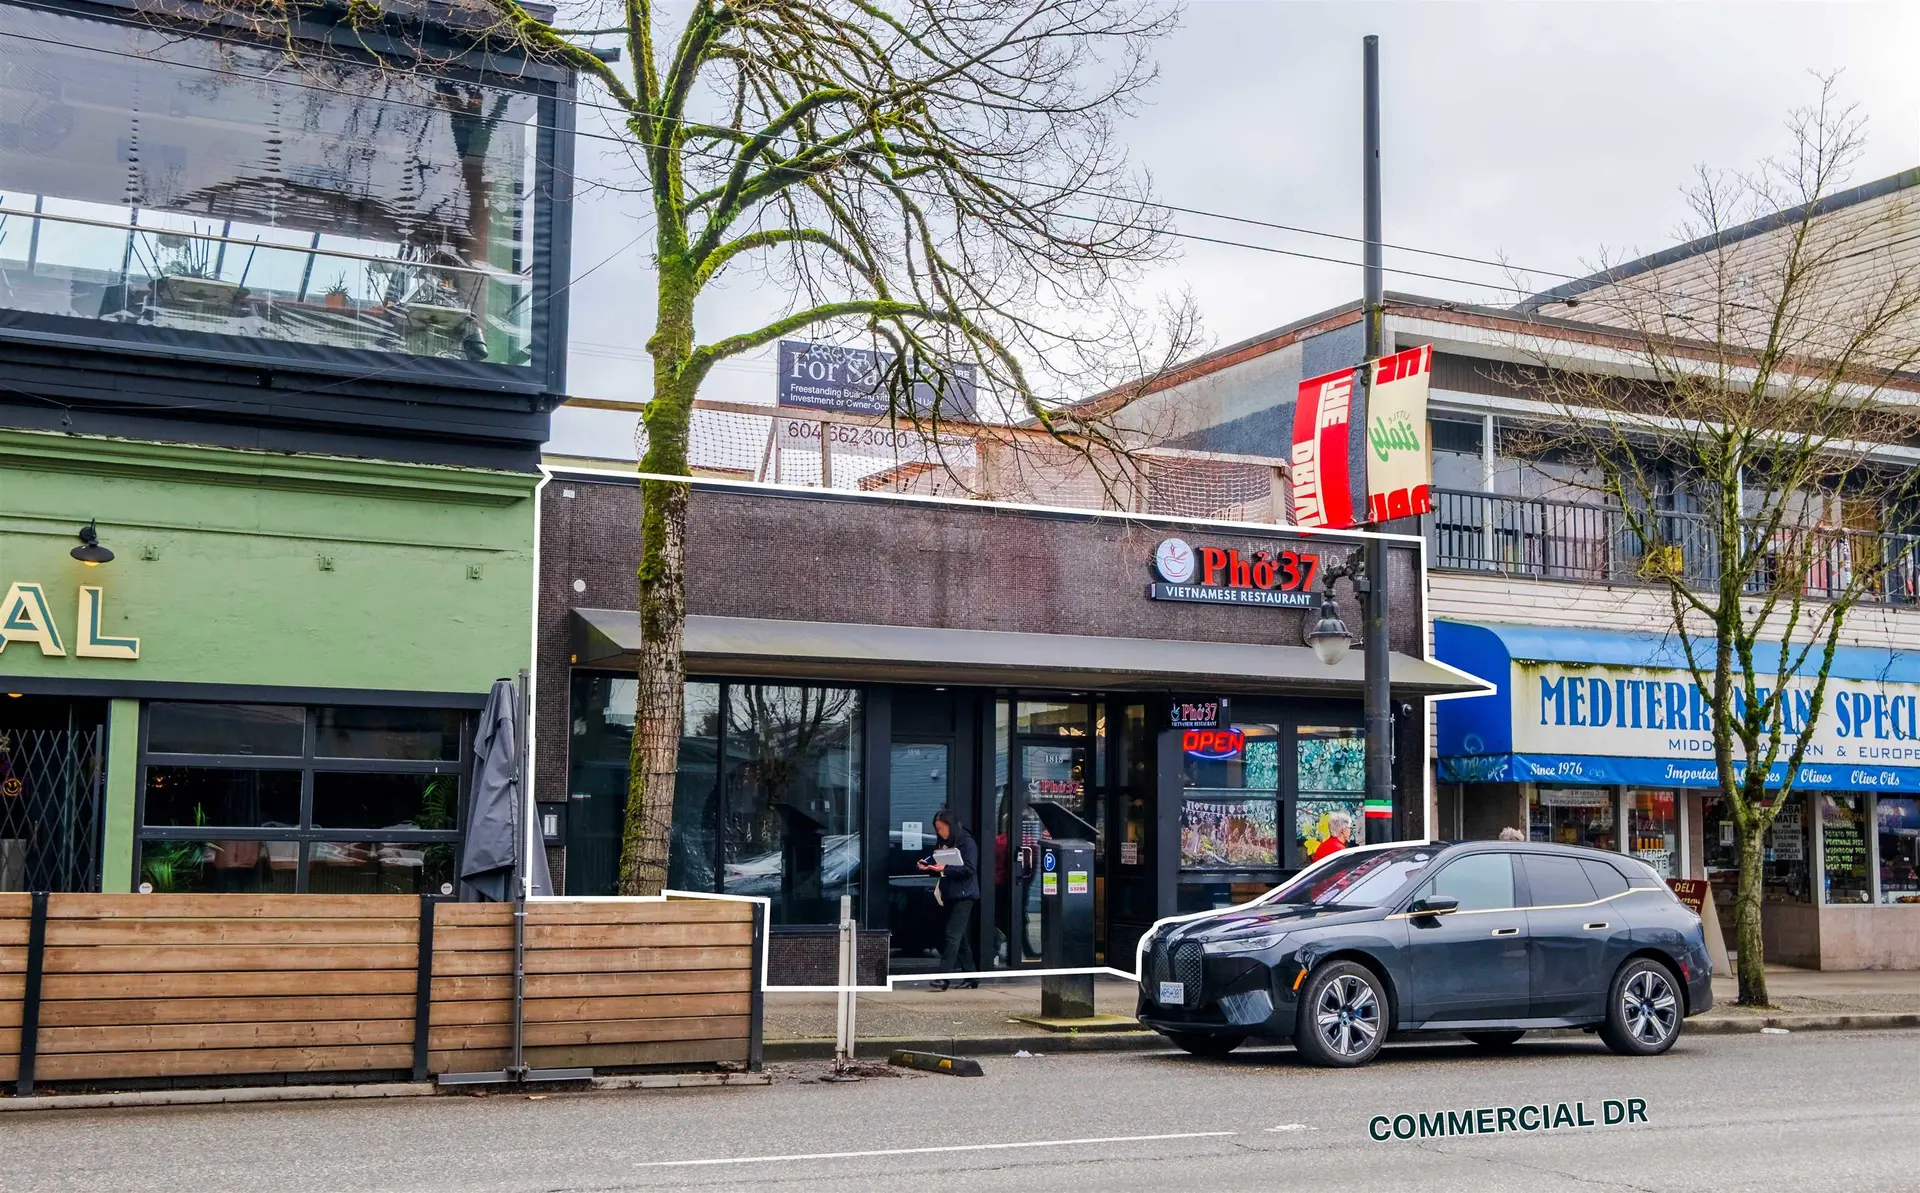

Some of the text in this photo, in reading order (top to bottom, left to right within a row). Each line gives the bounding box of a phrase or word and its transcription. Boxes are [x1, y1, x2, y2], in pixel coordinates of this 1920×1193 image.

[790, 351, 839, 382] For
[790, 383, 841, 398] Freestanding
[790, 393, 835, 406] Investment
[788, 421, 821, 439] 604
[861, 429, 908, 449] 3000
[1165, 586, 1311, 605] VIETNAMESE RESTAURANT
[1183, 731, 1244, 752] OPEN
[1836, 745, 1847, 757] &
[1529, 763, 1556, 776] Since
[1557, 762, 1583, 775] 1976
[1664, 763, 1719, 784] Imported
[1800, 768, 1833, 784] Olives
[1851, 769, 1901, 786] Olive Oils
[1674, 882, 1696, 893] DELI
